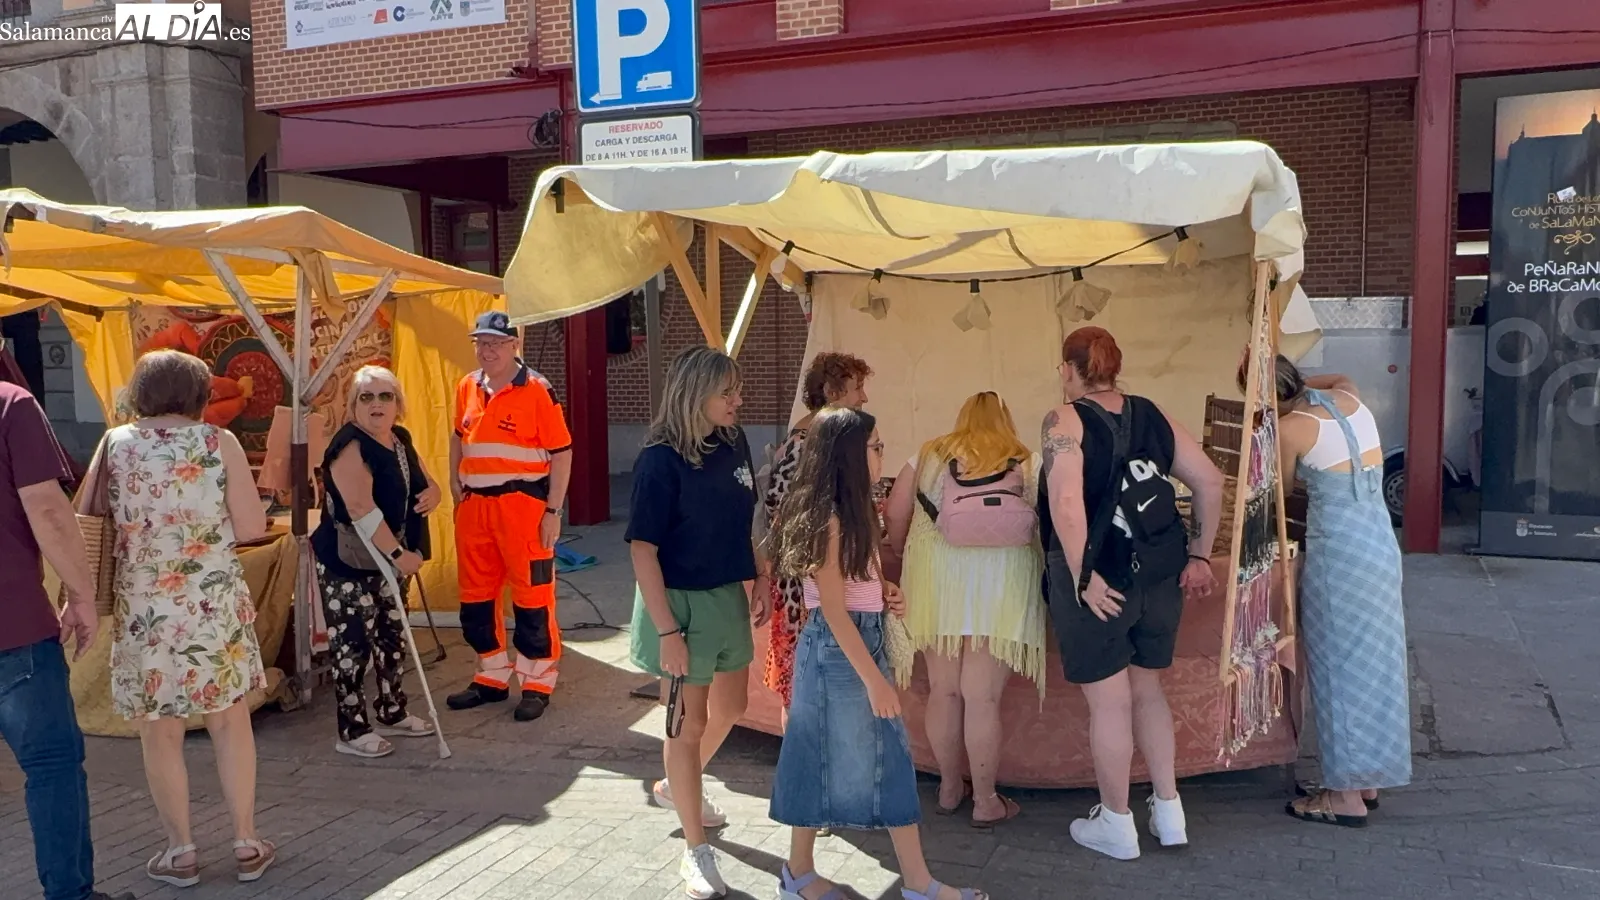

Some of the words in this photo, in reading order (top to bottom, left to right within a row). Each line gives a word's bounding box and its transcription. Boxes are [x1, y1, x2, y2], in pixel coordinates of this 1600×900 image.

[596, 0, 671, 95] P
[608, 120, 664, 134] RESERVADO
[595, 138, 623, 148] CARGA
[625, 137, 631, 145] Y
[632, 133, 678, 145] DESCARGA
[585, 153, 596, 162] DE
[604, 152, 610, 160] A
[630, 150, 635, 158] Y
[637, 149, 649, 158] DE
[662, 148, 667, 156] A
